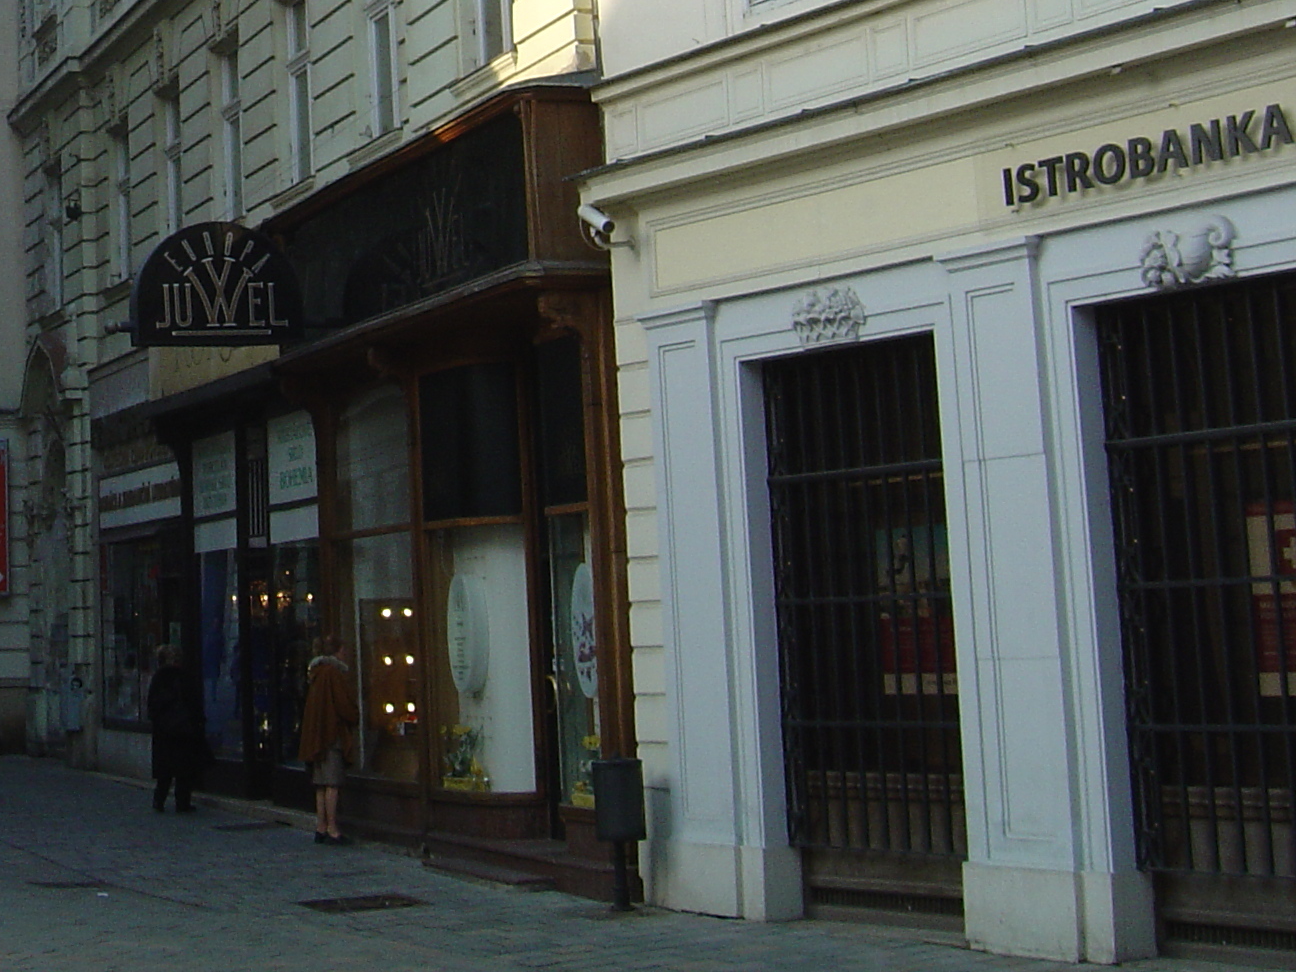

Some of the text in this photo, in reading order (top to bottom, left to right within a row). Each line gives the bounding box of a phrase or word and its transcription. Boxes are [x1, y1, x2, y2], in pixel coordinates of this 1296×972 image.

[1002, 103, 1295, 207] ISTROBANKA
[163, 231, 271, 274] EUROPA
[155, 257, 290, 330] JUWEL
[279, 466, 314, 490] BOHEMIA
